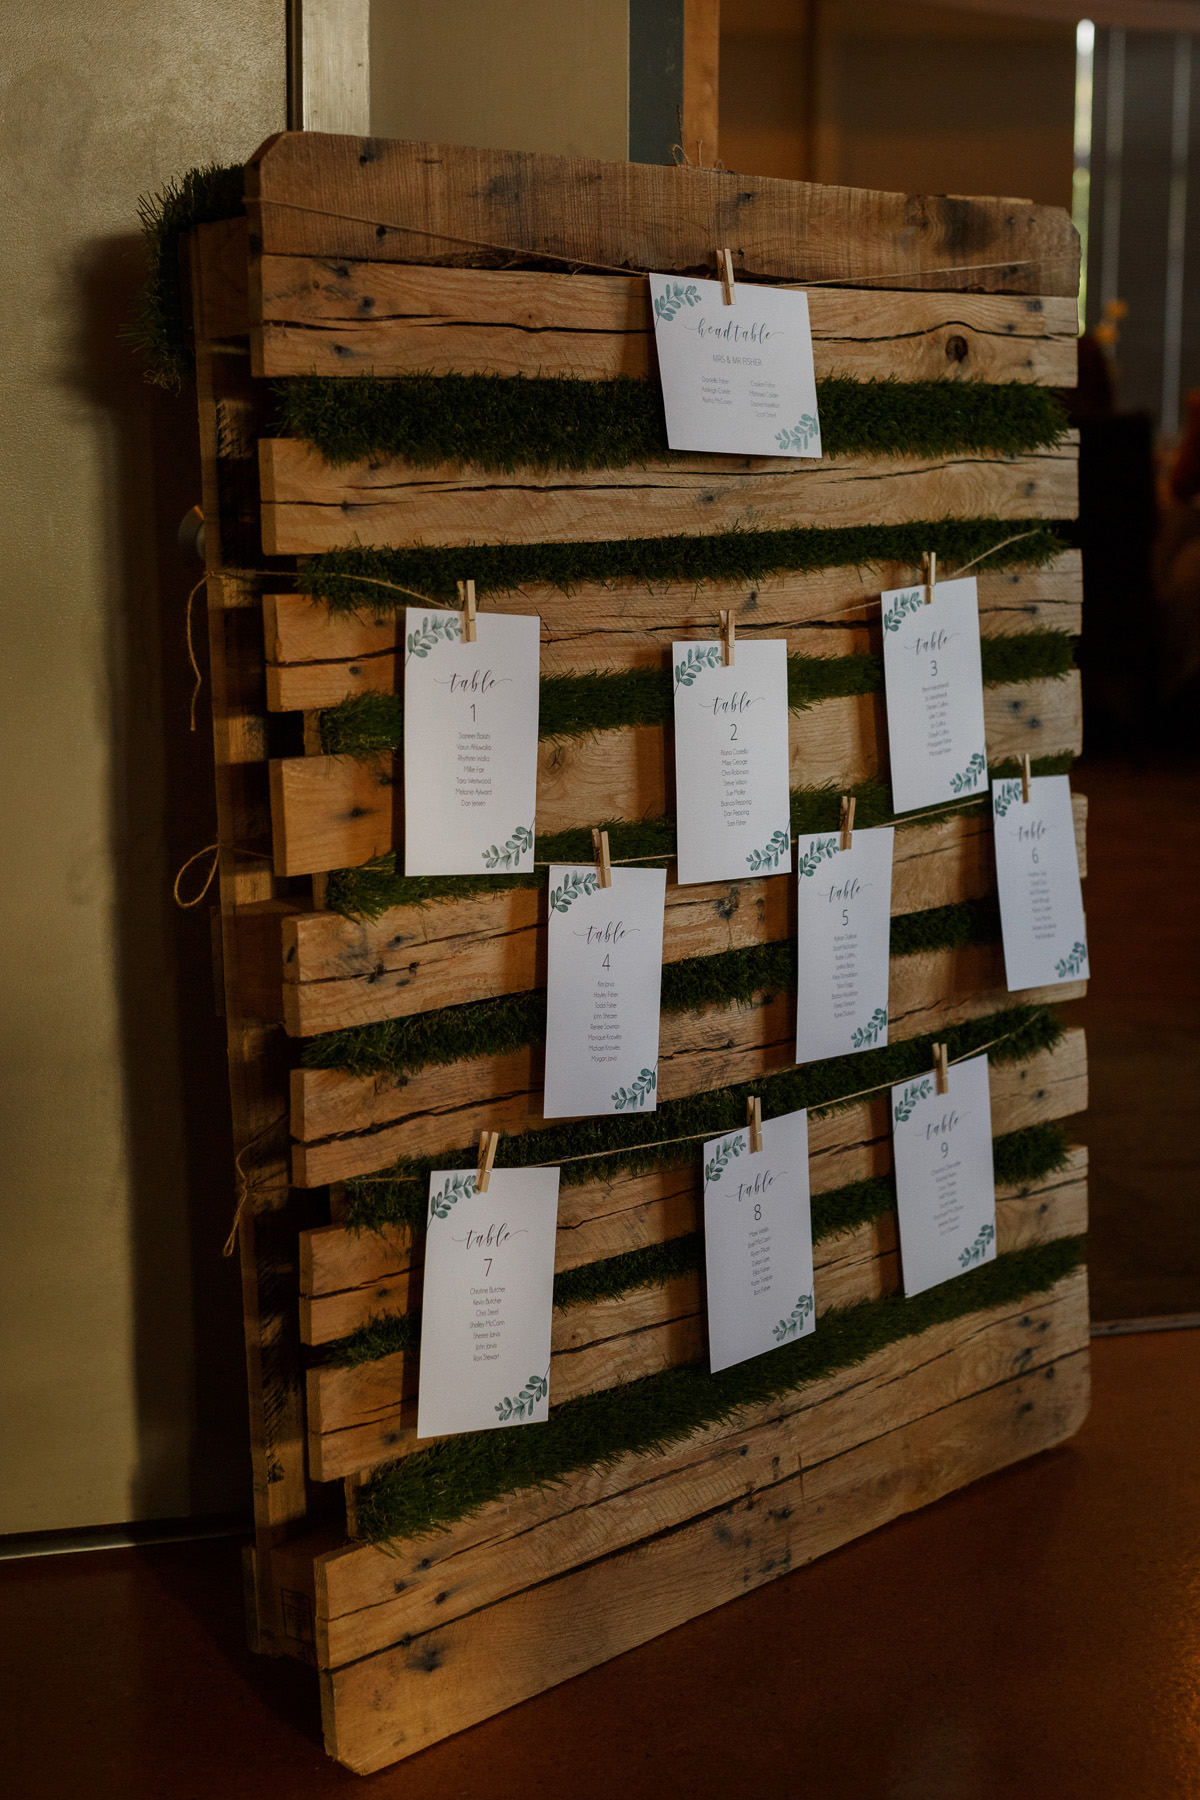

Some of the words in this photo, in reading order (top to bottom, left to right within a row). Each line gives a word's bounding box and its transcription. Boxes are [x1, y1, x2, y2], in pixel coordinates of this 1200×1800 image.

[713, 354, 725, 364] MRS
[726, 355, 732, 364] &
[732, 356, 742, 365] MR
[742, 357, 763, 366] FISHER
[702, 375, 718, 384] Danielle
[904, 629, 960, 655] table
[930, 660, 938, 677] 3
[433, 669, 513, 694] table
[699, 690, 766, 716] table
[470, 703, 476, 722] 1
[729, 723, 738, 741] 2
[467, 777, 492, 785] Westwood
[455, 788, 475, 796] Melanie
[461, 799, 471, 807] Dan
[1009, 820, 1056, 842] table
[1031, 847, 1039, 864] 6
[818, 878, 873, 903] table
[841, 909, 849, 927] 5
[572, 920, 641, 945] table
[601, 953, 611, 972] 4
[593, 1012, 603, 1020] John
[914, 1110, 972, 1141] table
[940, 1141, 949, 1159] 9
[725, 1169, 788, 1202] table
[753, 1204, 762, 1221] 8
[451, 1222, 529, 1250] table
[483, 1257, 493, 1277] 7
[469, 1287, 489, 1296] Christine
[488, 1286, 506, 1294] Butcher
[473, 1298, 485, 1306] Kevin
[475, 1309, 487, 1317] Chris
[487, 1309, 499, 1317] Steel
[469, 1321, 485, 1329] Shelley
[489, 1331, 501, 1339] Jarvis
[475, 1343, 485, 1351] John
[485, 1343, 498, 1351] Jarvis
[473, 1354, 483, 1362] Ron
[482, 1354, 500, 1362] Stewart
